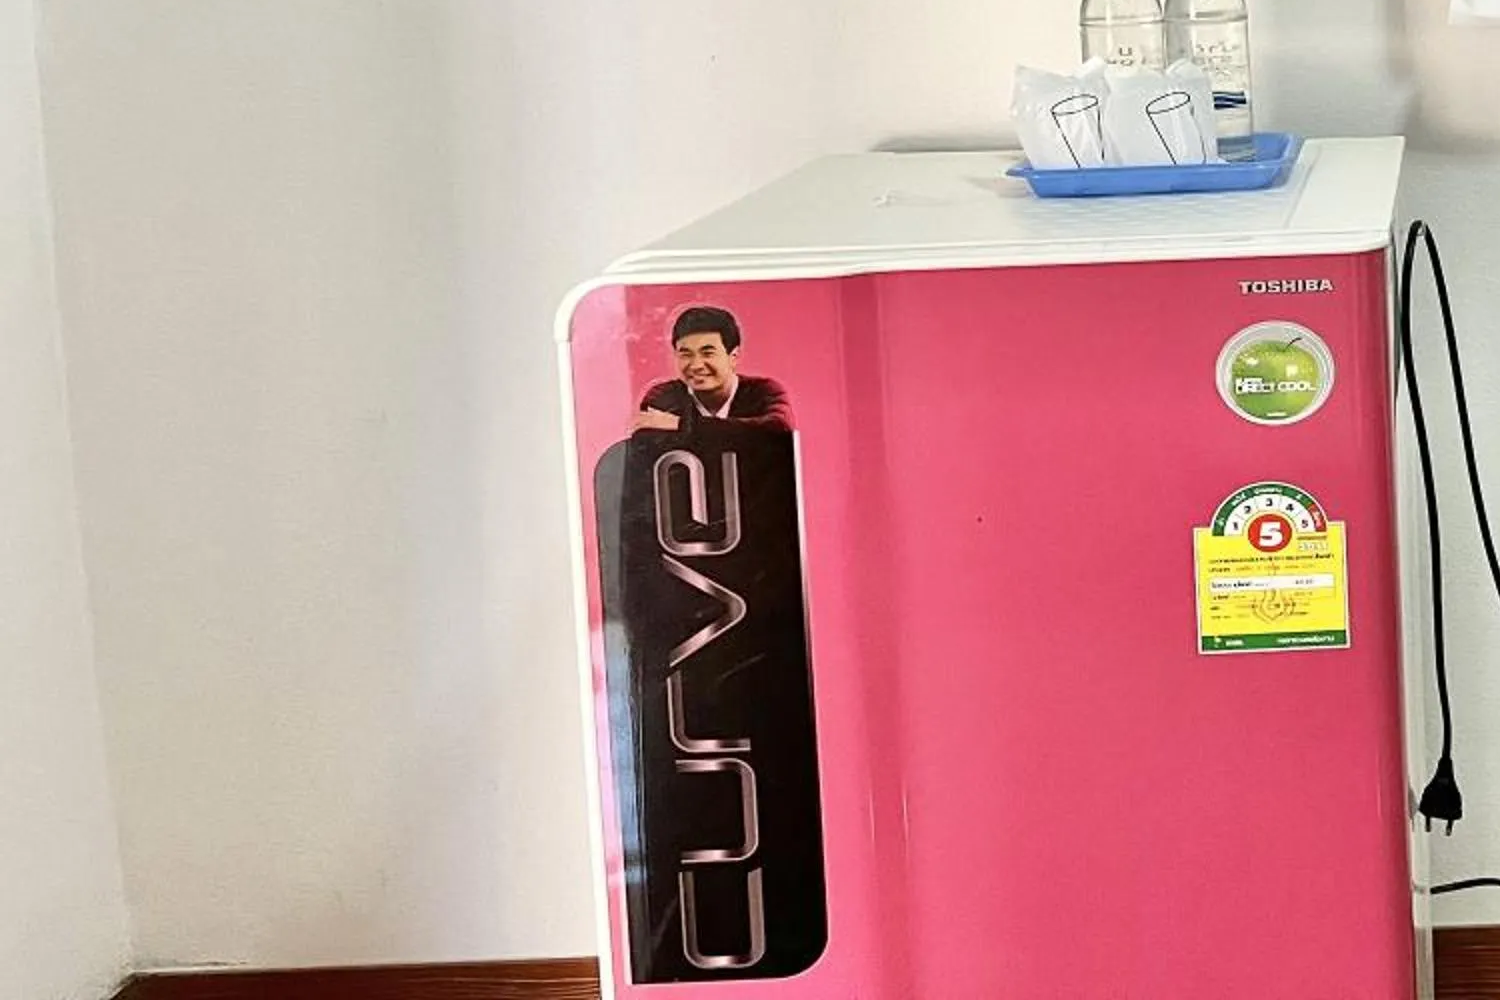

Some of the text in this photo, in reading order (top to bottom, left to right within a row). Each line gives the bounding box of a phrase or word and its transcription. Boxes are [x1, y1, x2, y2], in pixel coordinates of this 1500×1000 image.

[1238, 279, 1334, 295] TOSHIBA
[1277, 381, 1316, 392] COOL
[1232, 521, 1239, 531] 1
[1243, 505, 1251, 514] 2
[1265, 498, 1273, 507] 3
[1285, 503, 1294, 512] 4
[1301, 519, 1309, 528] 5
[1259, 521, 1283, 547] 5
